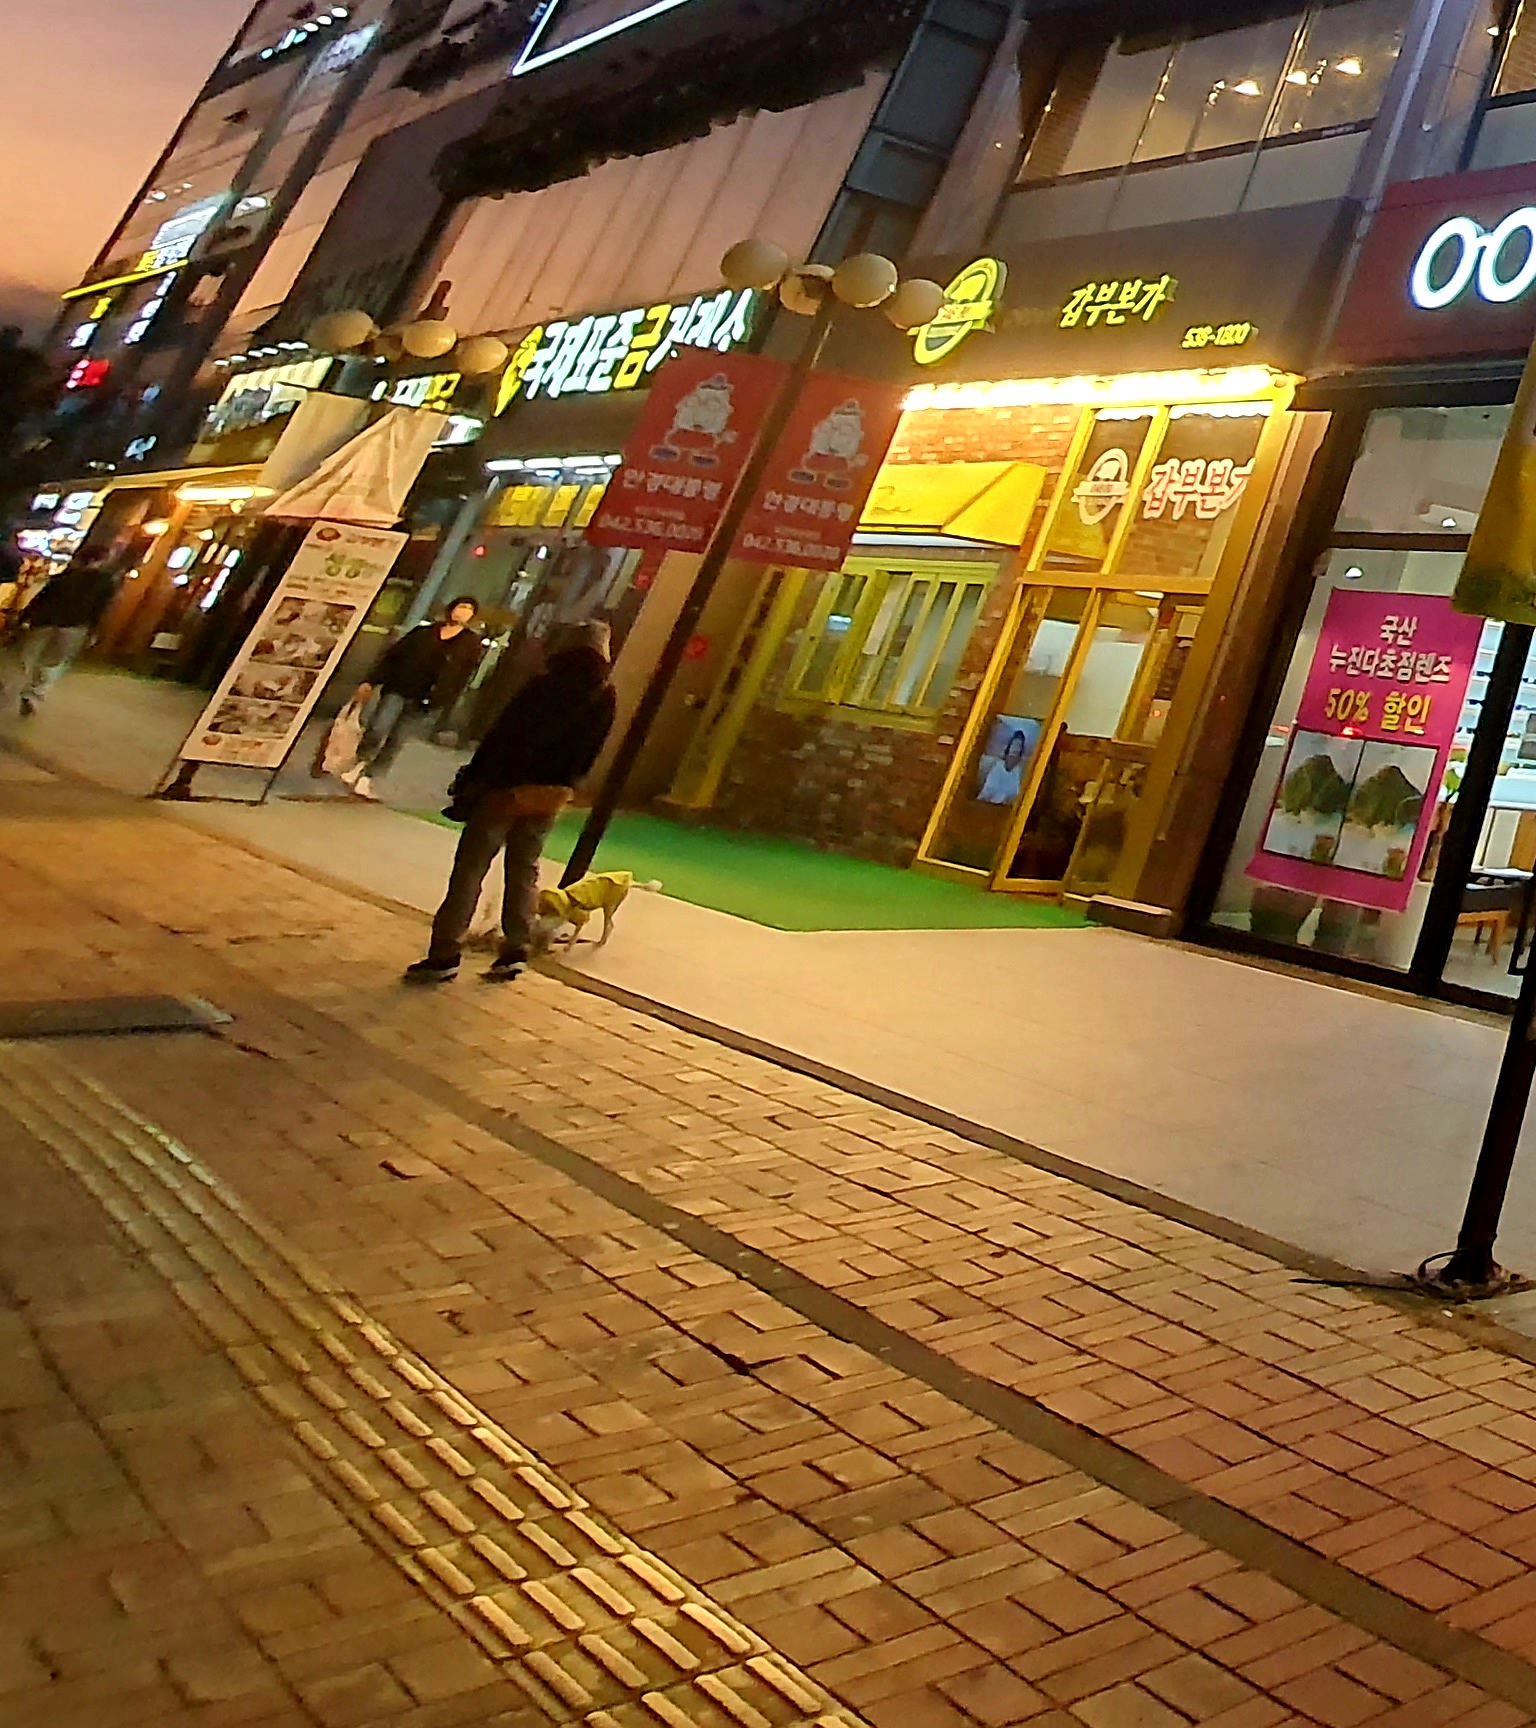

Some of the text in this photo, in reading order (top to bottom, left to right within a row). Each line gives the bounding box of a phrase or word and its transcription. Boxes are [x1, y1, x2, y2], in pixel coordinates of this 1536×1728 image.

[1060, 273, 1170, 328] 갑부본가
[1378, 614, 1419, 648] 국산
[1328, 644, 1452, 684] 누진다초점렌즈
[1323, 687, 1433, 736] 50% 할인
